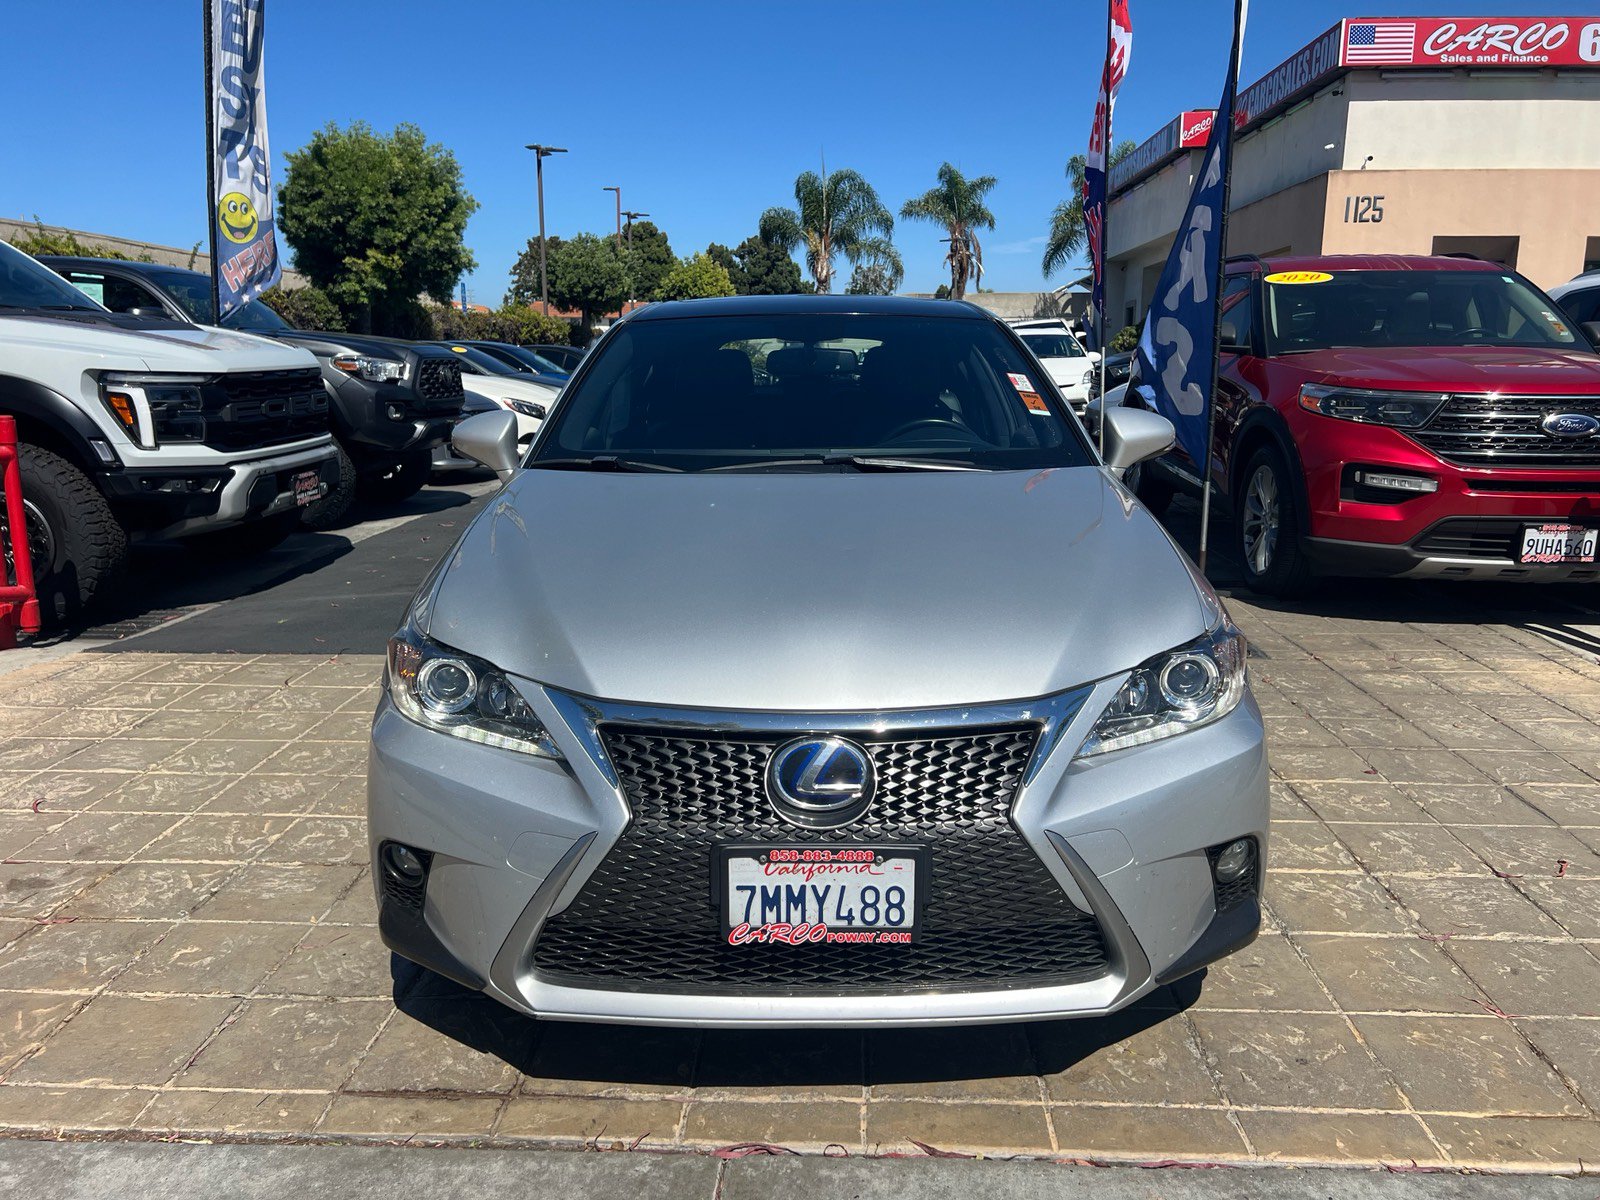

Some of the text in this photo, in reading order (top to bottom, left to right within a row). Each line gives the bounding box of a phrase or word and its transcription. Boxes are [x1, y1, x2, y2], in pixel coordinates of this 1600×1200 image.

[1423, 22, 1570, 56] CARCO
[1440, 54, 1548, 63] Sales and Finance
[1247, 28, 1341, 120] CARCOSALES.COM
[1181, 117, 1211, 140] CARCO
[1344, 196, 1385, 223] 1125
[1276, 273, 1321, 282] 2020
[1557, 418, 1588, 431] Ford
[1525, 538, 1593, 556] 9UHA560
[769, 850, 875, 862] 858-883-4888
[764, 861, 884, 882] California
[735, 884, 906, 927] 7MMY488
[728, 922, 828, 945] CARCO
